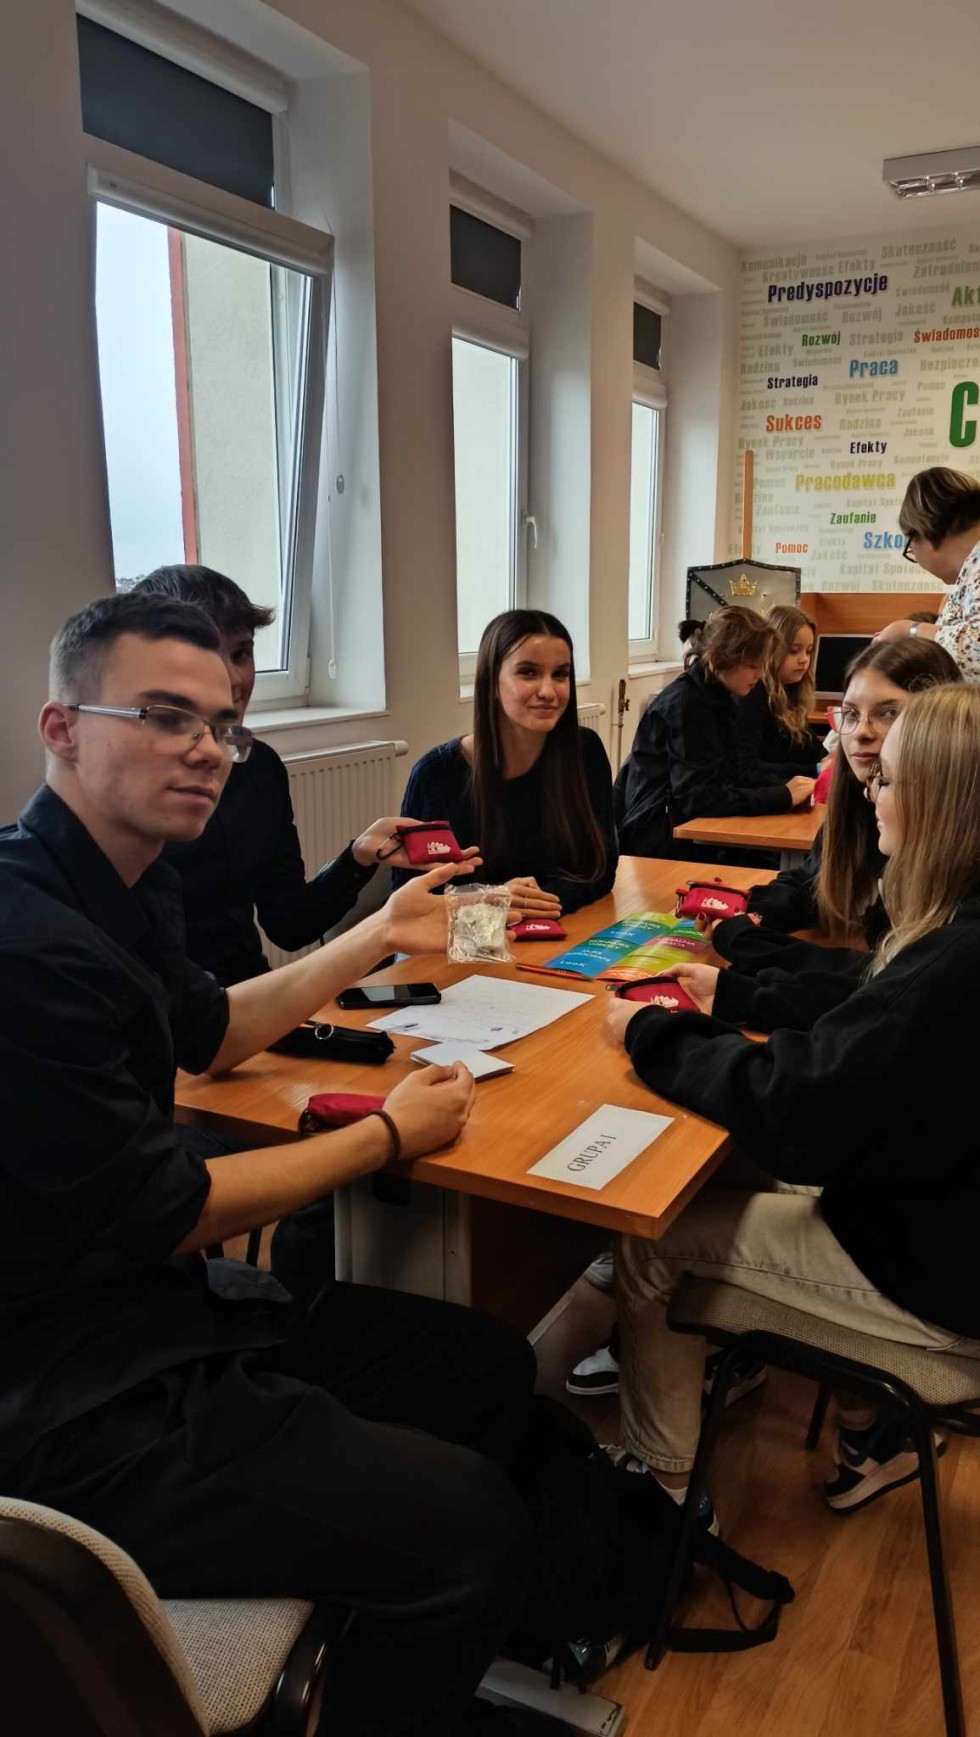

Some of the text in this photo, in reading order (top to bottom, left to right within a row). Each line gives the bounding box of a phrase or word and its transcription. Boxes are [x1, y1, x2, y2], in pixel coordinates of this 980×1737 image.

[768, 273, 888, 303] Predyspozycje
[801, 330, 841, 347] Rozwój
[849, 331, 904, 346] Strategia
[849, 359, 899, 379] Praca
[767, 373, 819, 390] Strategia
[766, 413, 822, 433] Sukces
[949, 381, 979, 448] C
[850, 440, 888, 454] Efekty
[795, 471, 897, 493] Pracodawca
[830, 510, 876, 525] Zaufanie
[775, 541, 809, 554] Pomoc
[864, 531, 906, 549] Szko
[567, 1140, 612, 1171] GRUPA
